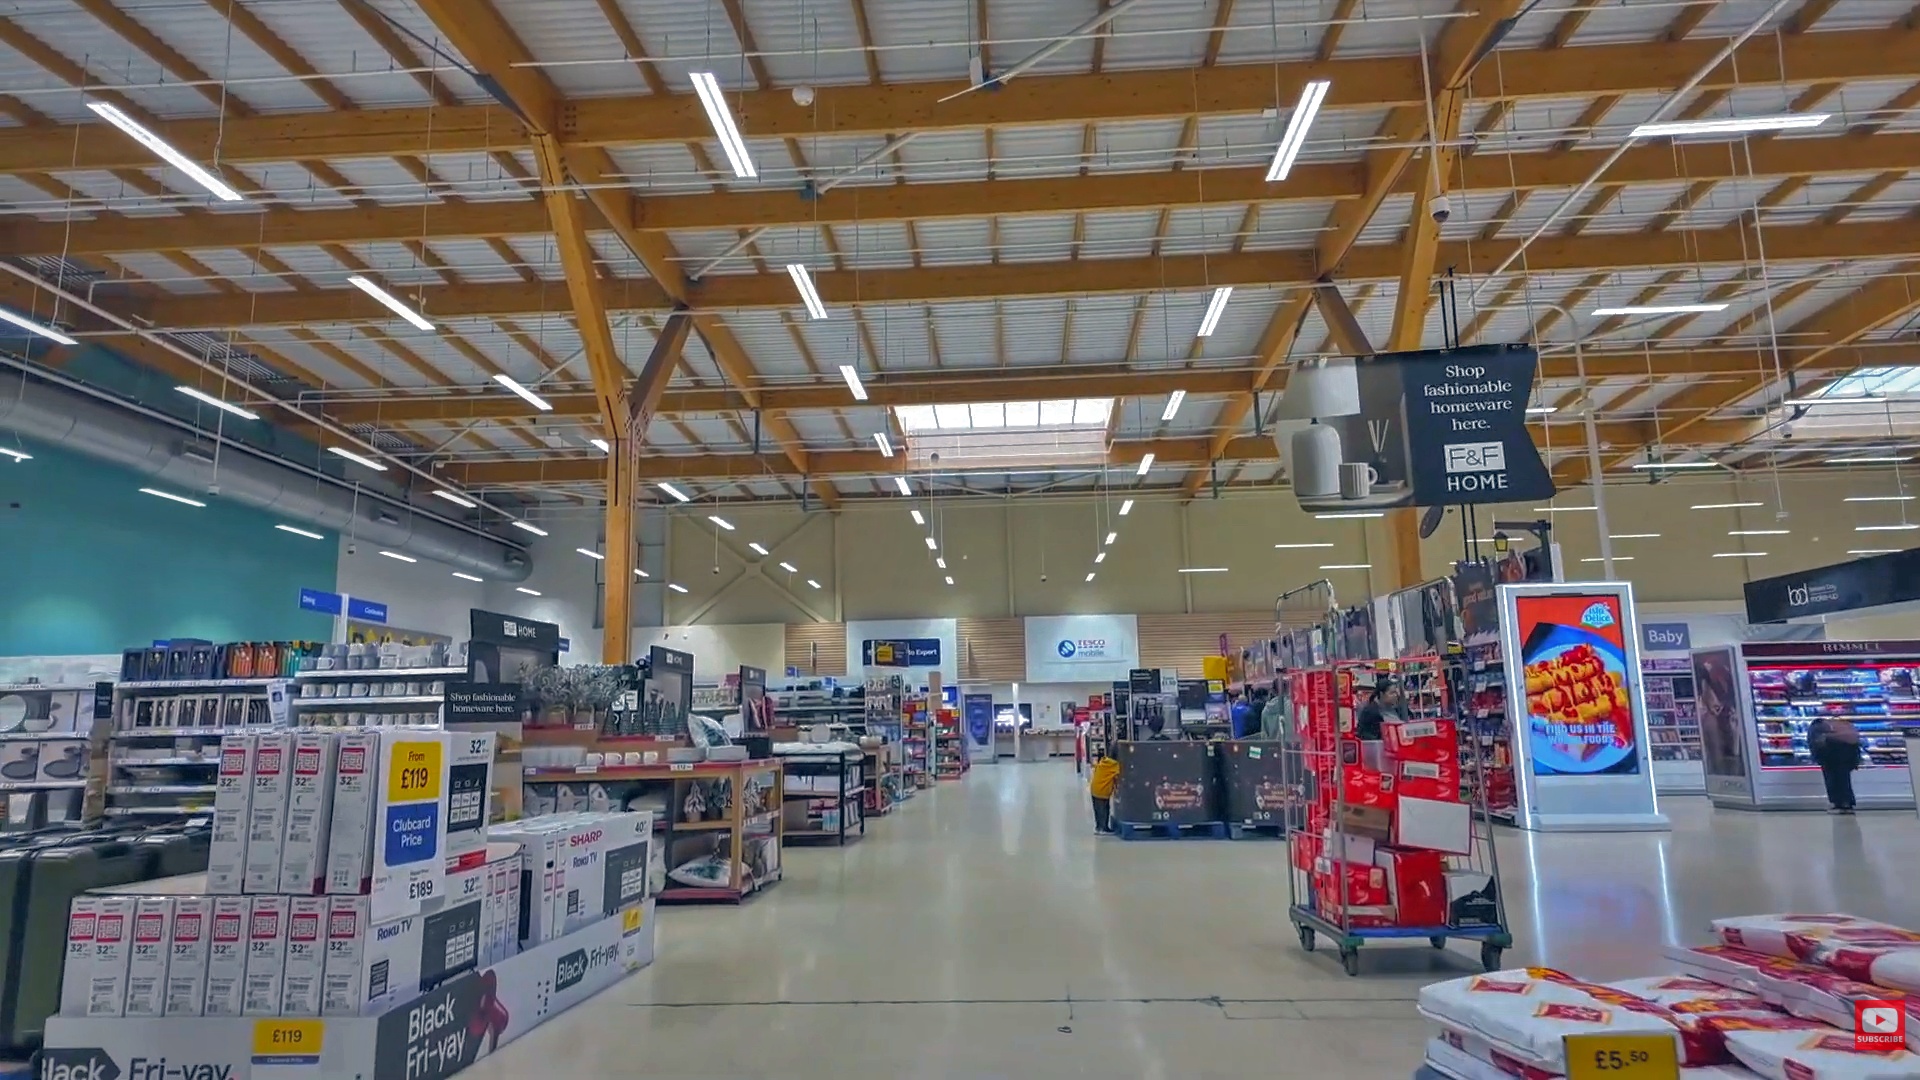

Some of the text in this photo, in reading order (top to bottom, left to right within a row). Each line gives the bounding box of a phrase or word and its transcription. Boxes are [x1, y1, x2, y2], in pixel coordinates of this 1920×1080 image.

[1445, 365, 1485, 379] Shop
[1424, 380, 1512, 397] fashionable
[1430, 399, 1512, 414] homeware
[1452, 418, 1491, 431] here.
[1449, 445, 1499, 469] F&F
[1447, 473, 1509, 492] HOME
[518, 626, 537, 638] HOME
[1648, 629, 1685, 645] Baby
[1078, 639, 1106, 647] TESCO
[1078, 649, 1105, 658] mobile
[450, 692, 517, 704] Shop fashionable
[452, 703, 515, 713] homeware here.
[1569, 724, 1583, 733] US
[408, 751, 425, 762] From
[401, 767, 428, 789] £119
[393, 816, 430, 832] Clubcard
[401, 834, 422, 848] Price
[570, 830, 602, 847] SHARP
[589, 852, 597, 864] TV
[409, 880, 433, 899] £189
[401, 918, 413, 932] TV
[557, 954, 584, 985] Black
[408, 992, 456, 1044] Black
[273, 1029, 302, 1043] £119
[406, 1027, 467, 1080] Fri-yay
[1595, 1049, 1649, 1070] £5.50
